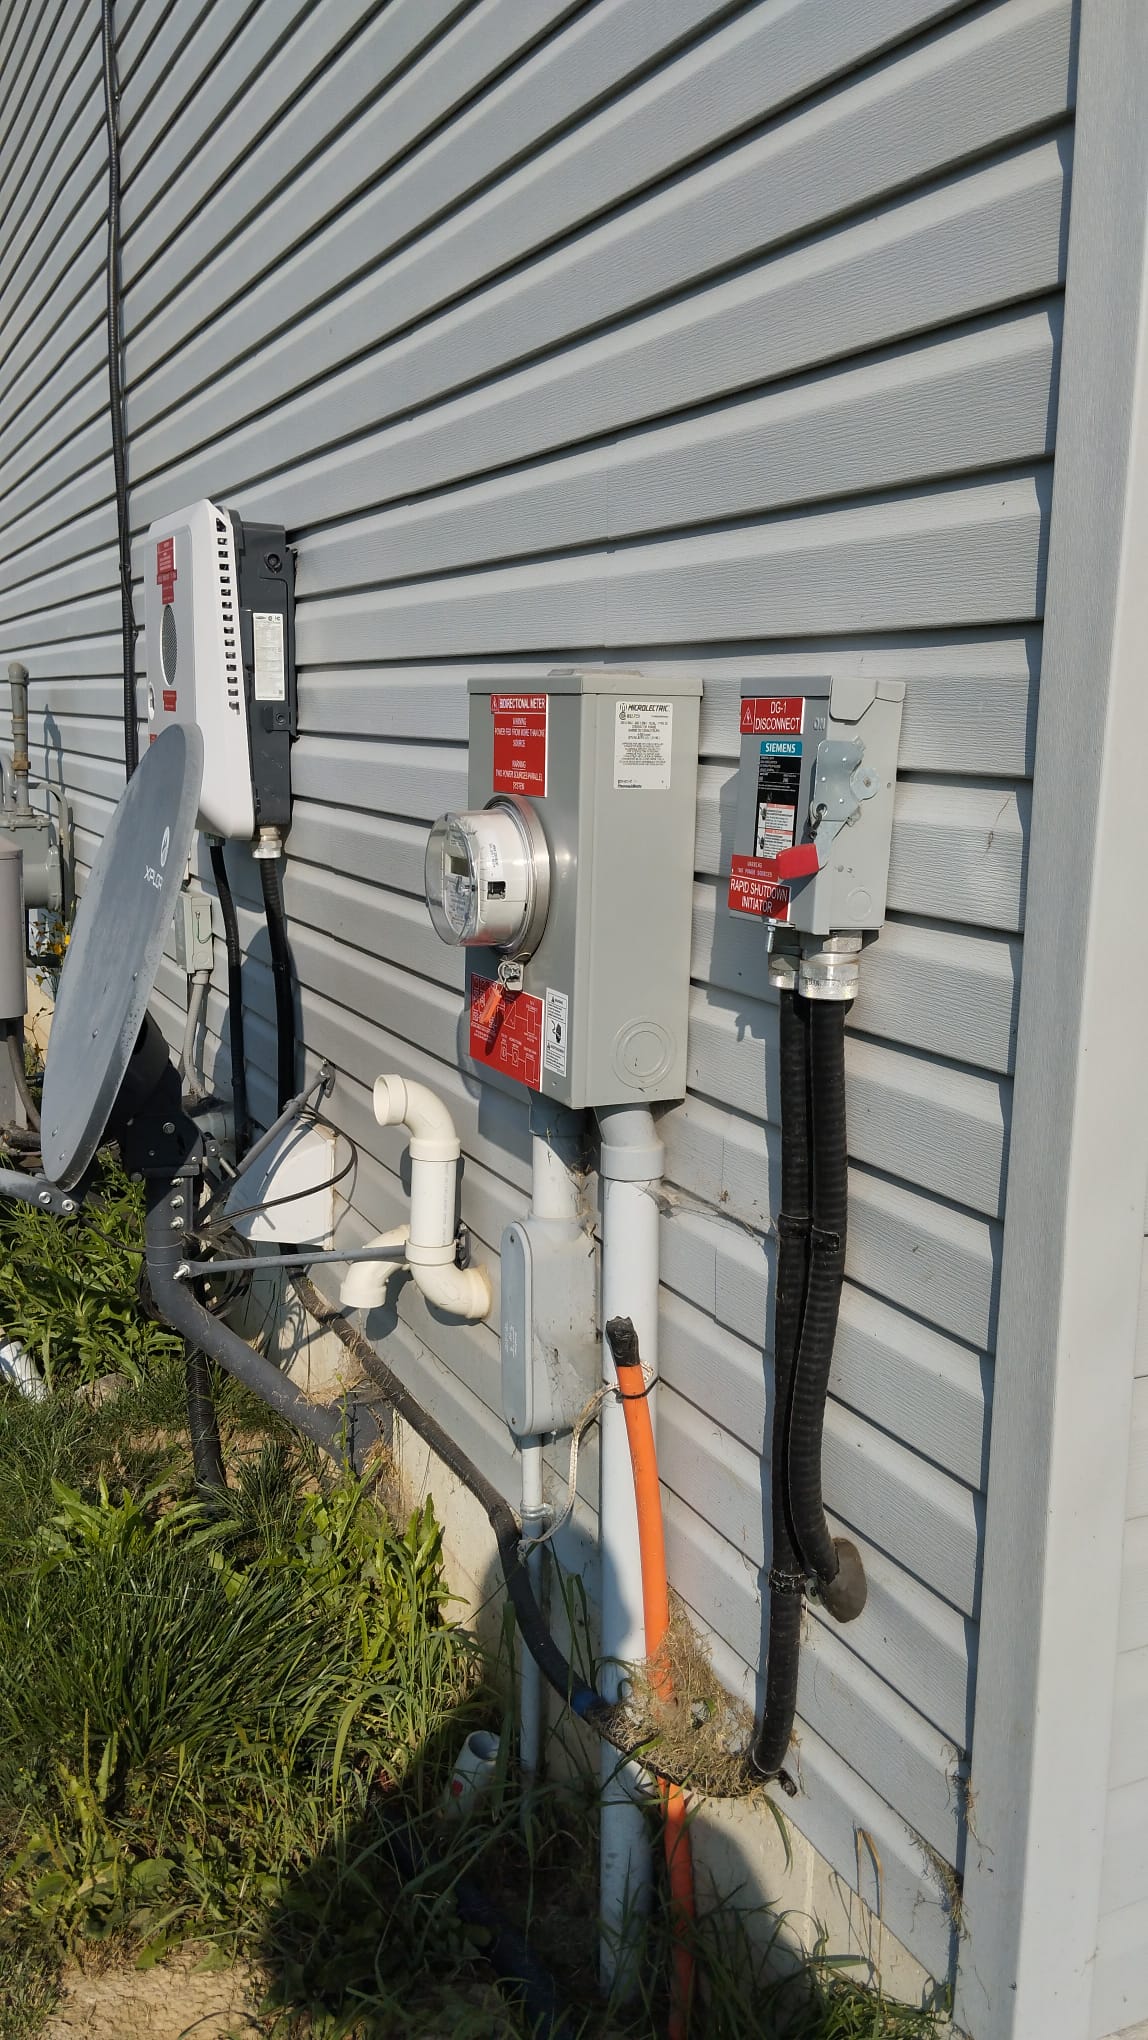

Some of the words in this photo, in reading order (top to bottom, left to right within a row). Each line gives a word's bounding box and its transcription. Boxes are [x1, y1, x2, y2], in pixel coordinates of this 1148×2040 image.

[770, 700, 787, 714] DG-1
[755, 717, 800, 731] DISCONNECT
[813, 717, 826, 731] ON
[765, 742, 796, 754] SIEMENS
[730, 878, 750, 894] RAPID
[750, 882, 788, 902] SHUTDOWN
[741, 895, 773, 914] INITIATOR
